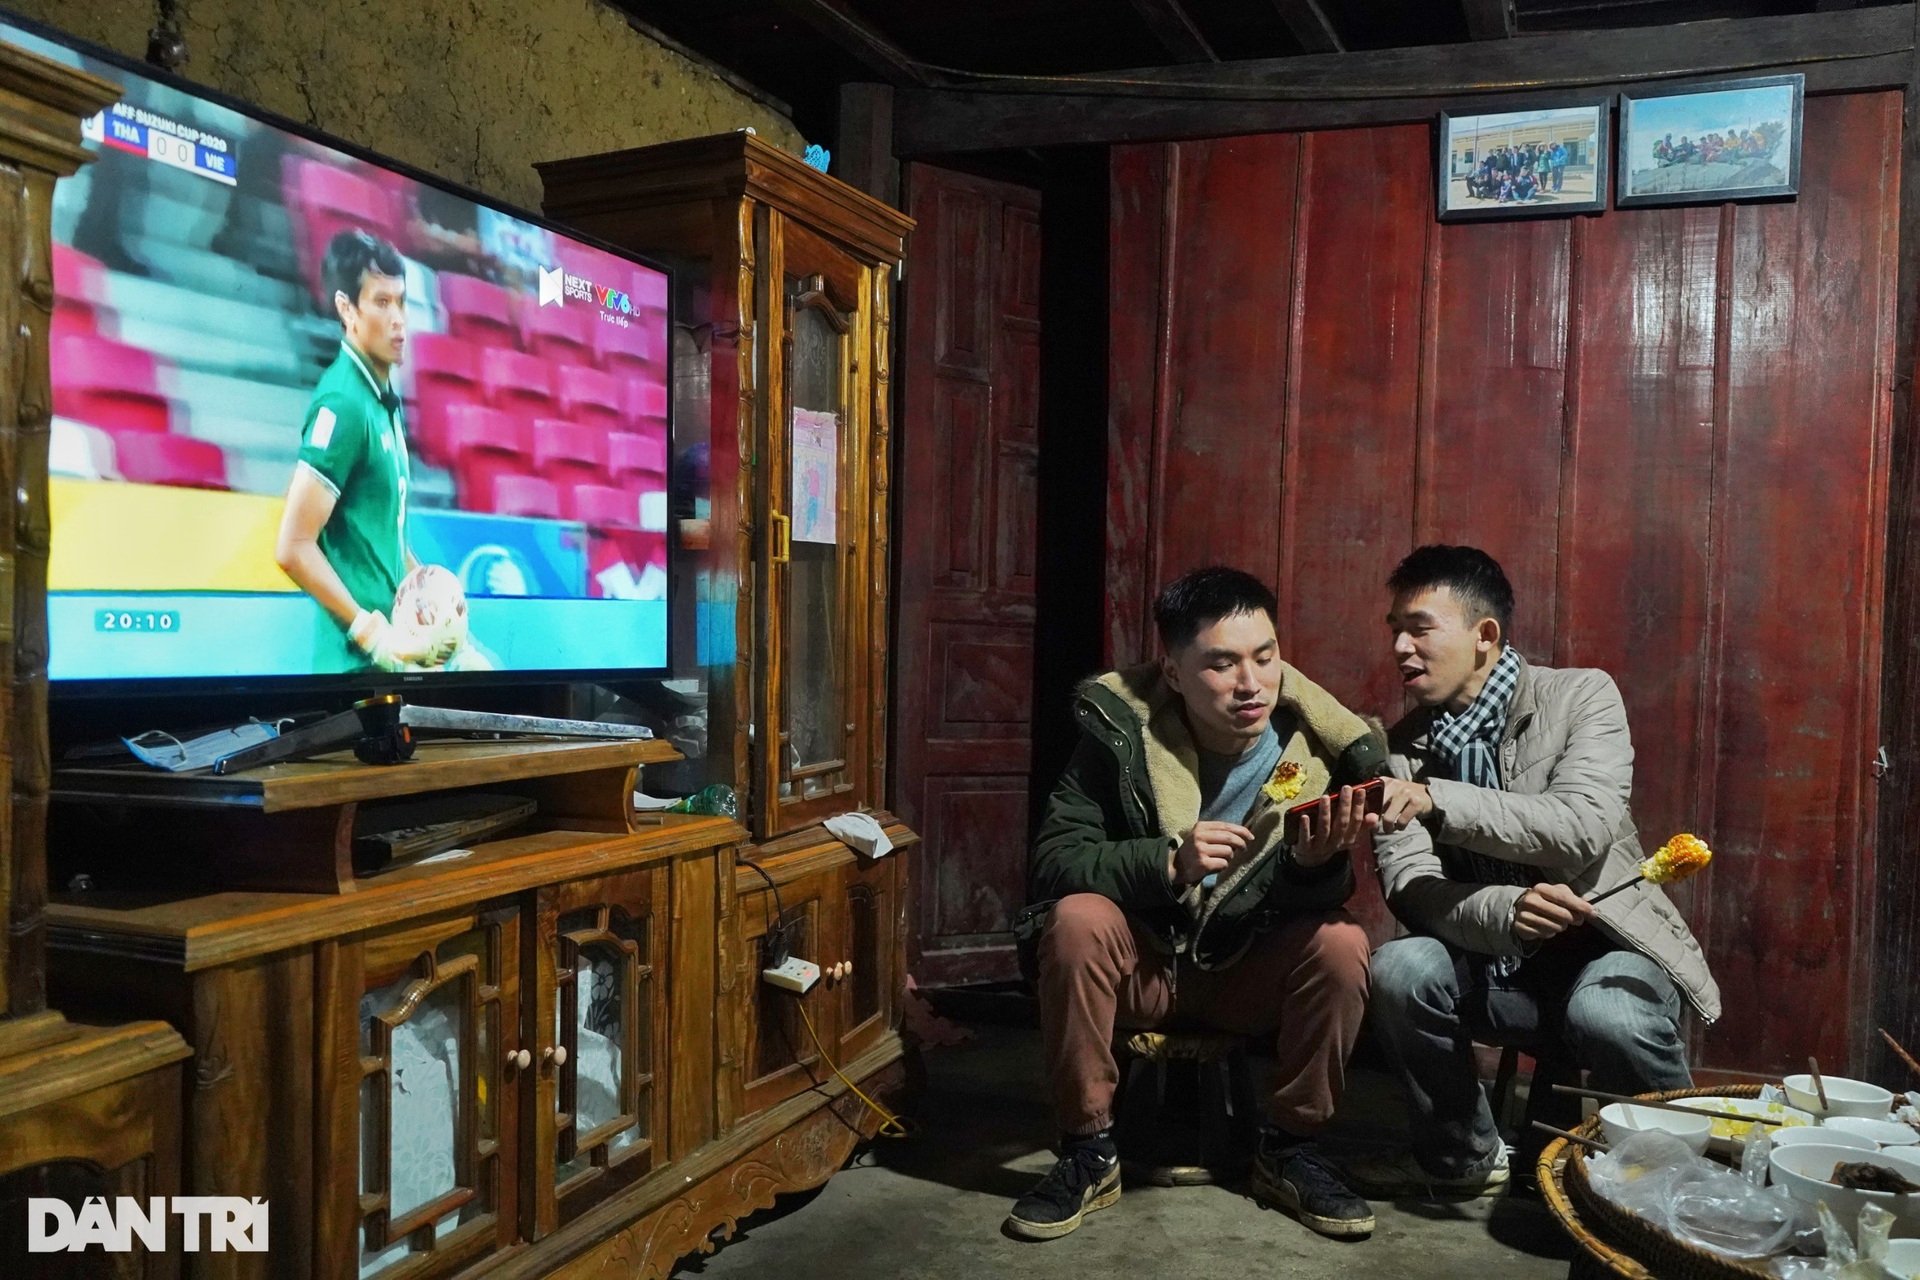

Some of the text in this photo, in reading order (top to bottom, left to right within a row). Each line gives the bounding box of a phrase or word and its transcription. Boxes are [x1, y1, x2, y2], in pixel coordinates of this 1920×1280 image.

[112, 102, 227, 152] AFF SUZUKI CUP 2020
[112, 120, 225, 172] THA 0 0 VIE
[564, 273, 592, 292] NEXT
[564, 285, 593, 303] SPORTS
[104, 612, 172, 630] 20:10
